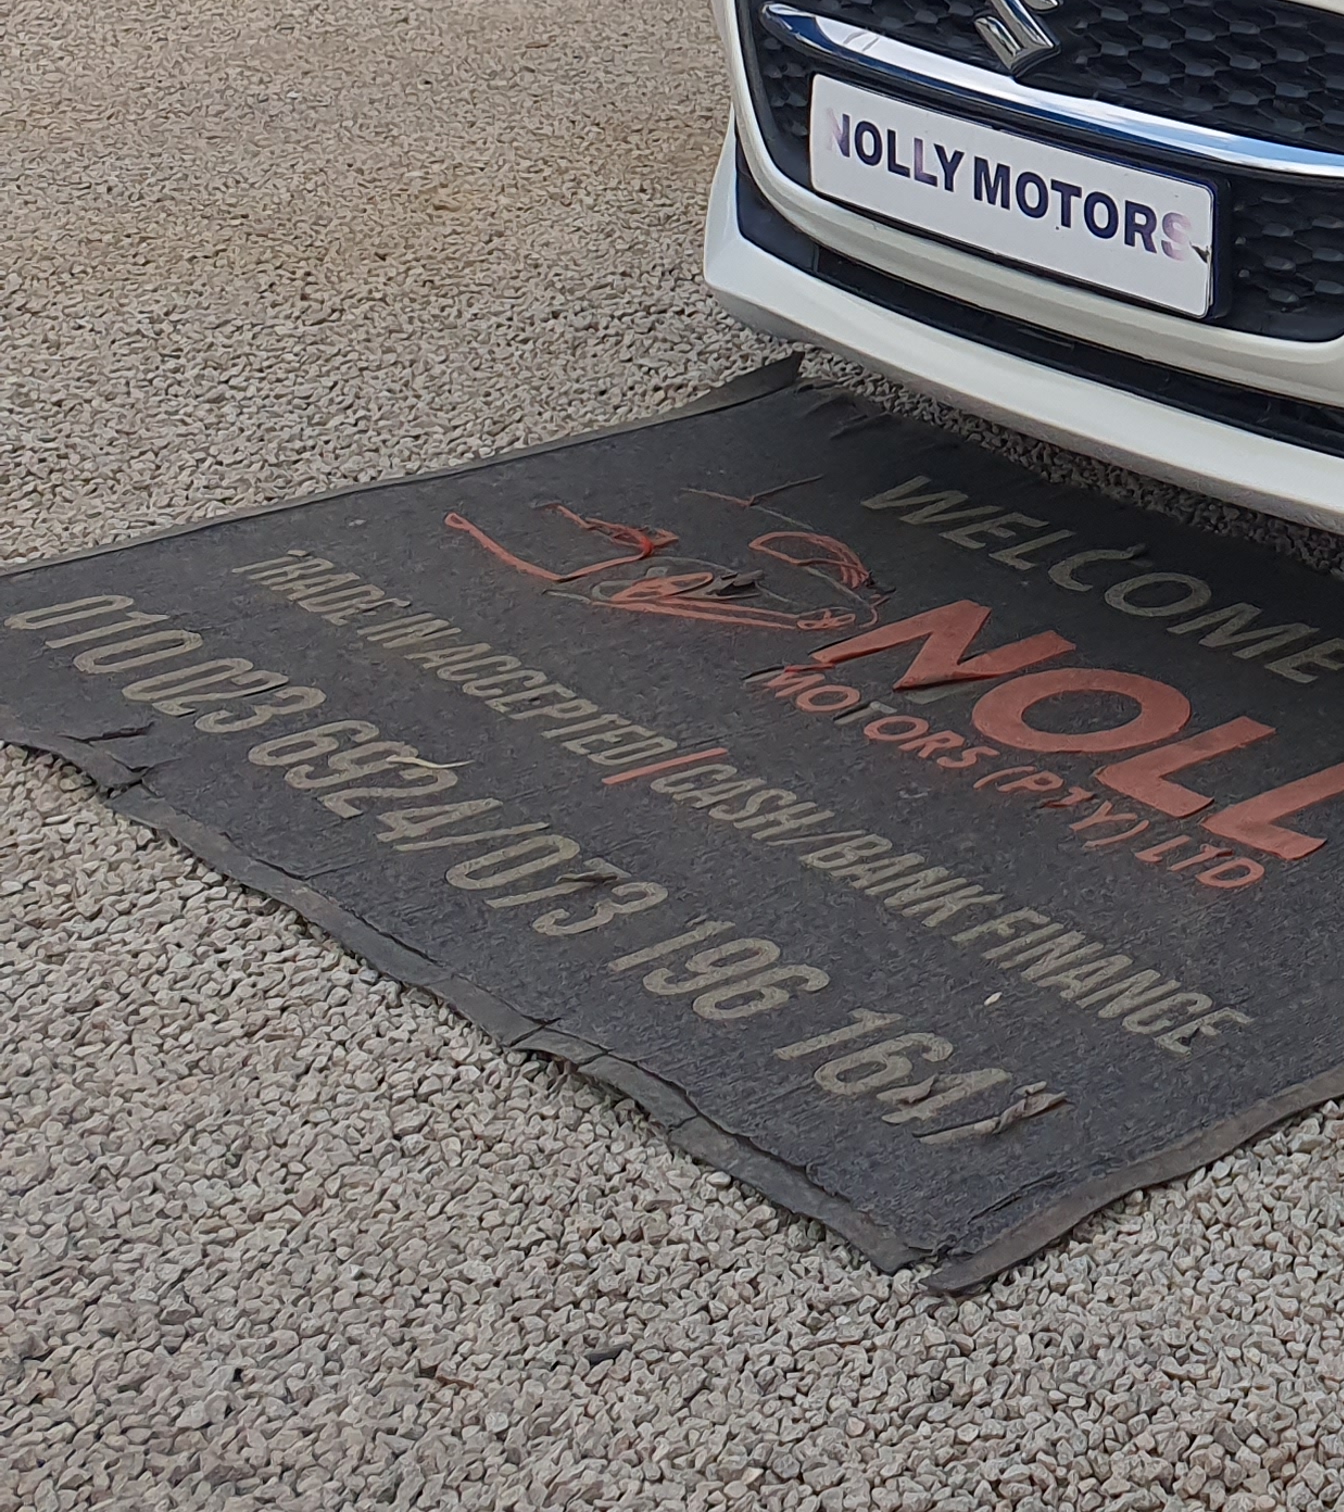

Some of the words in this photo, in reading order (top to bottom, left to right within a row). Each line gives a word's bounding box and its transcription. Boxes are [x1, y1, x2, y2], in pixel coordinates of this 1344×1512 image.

[826, 107, 965, 193] NOLLY
[973, 155, 1193, 262] MOTORS
[1133, 834, 1266, 889] LTD
[606, 917, 831, 1020] 196
[952, 906, 1258, 1058] FINANCE
